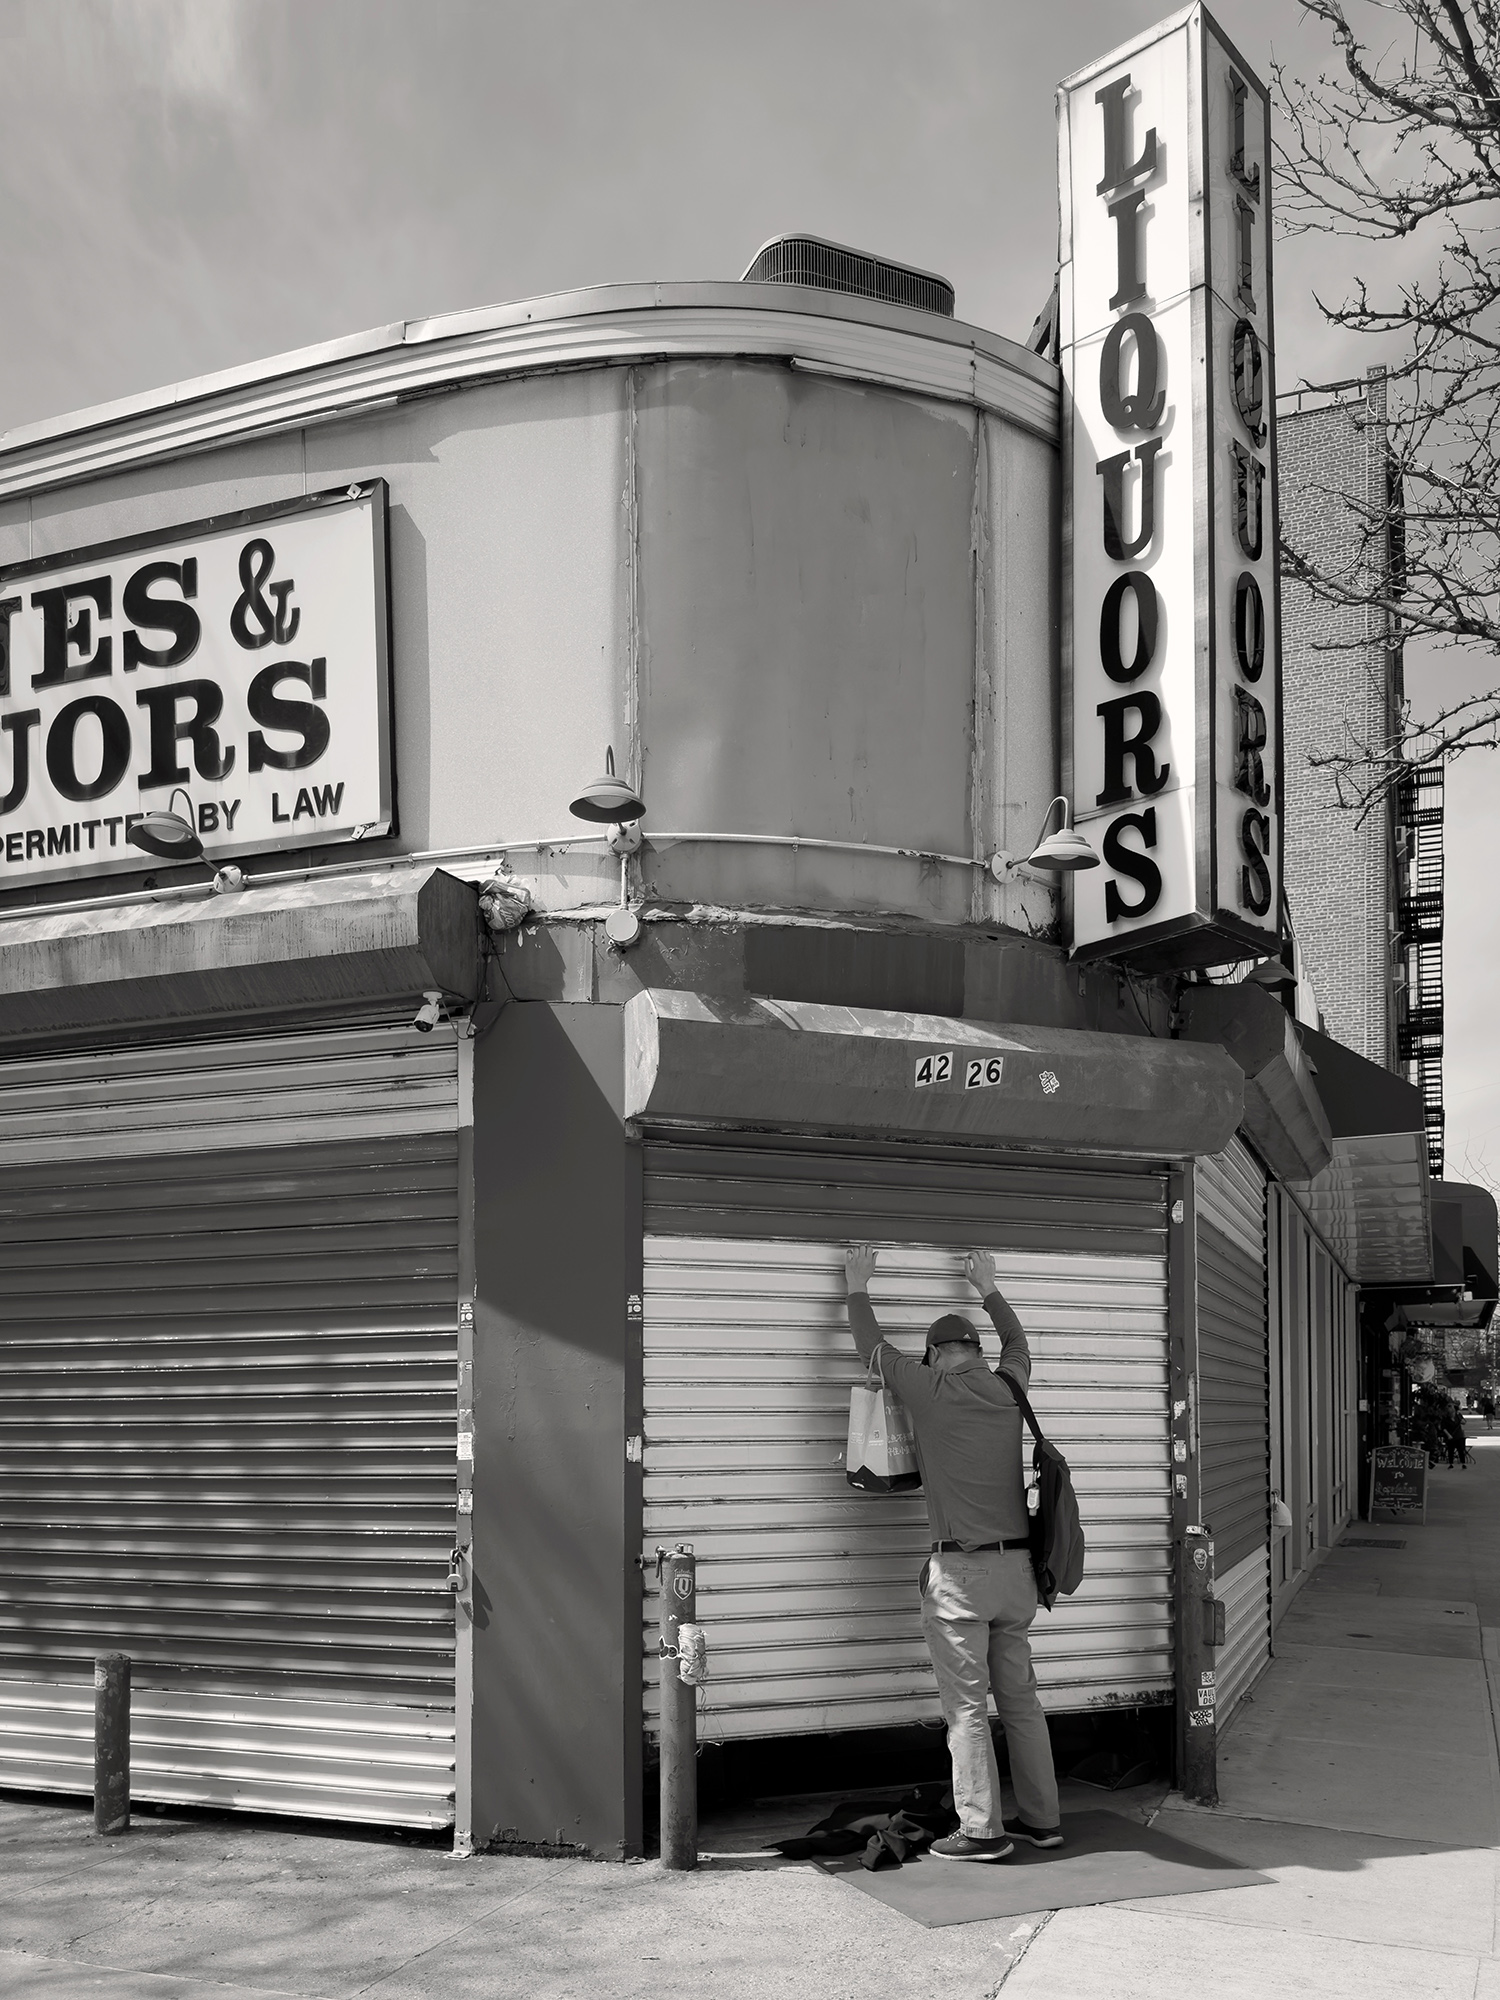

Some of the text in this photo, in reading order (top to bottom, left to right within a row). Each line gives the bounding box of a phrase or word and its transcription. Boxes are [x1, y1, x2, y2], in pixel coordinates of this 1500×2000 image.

[1095, 73, 1171, 924] LIQUORS
[1226, 65, 1272, 918] LIQUORS
[0, 538, 301, 696] ES &
[0, 782, 345, 863] ERMITTE BY LAW
[917, 1055, 1001, 1087] 42 26
